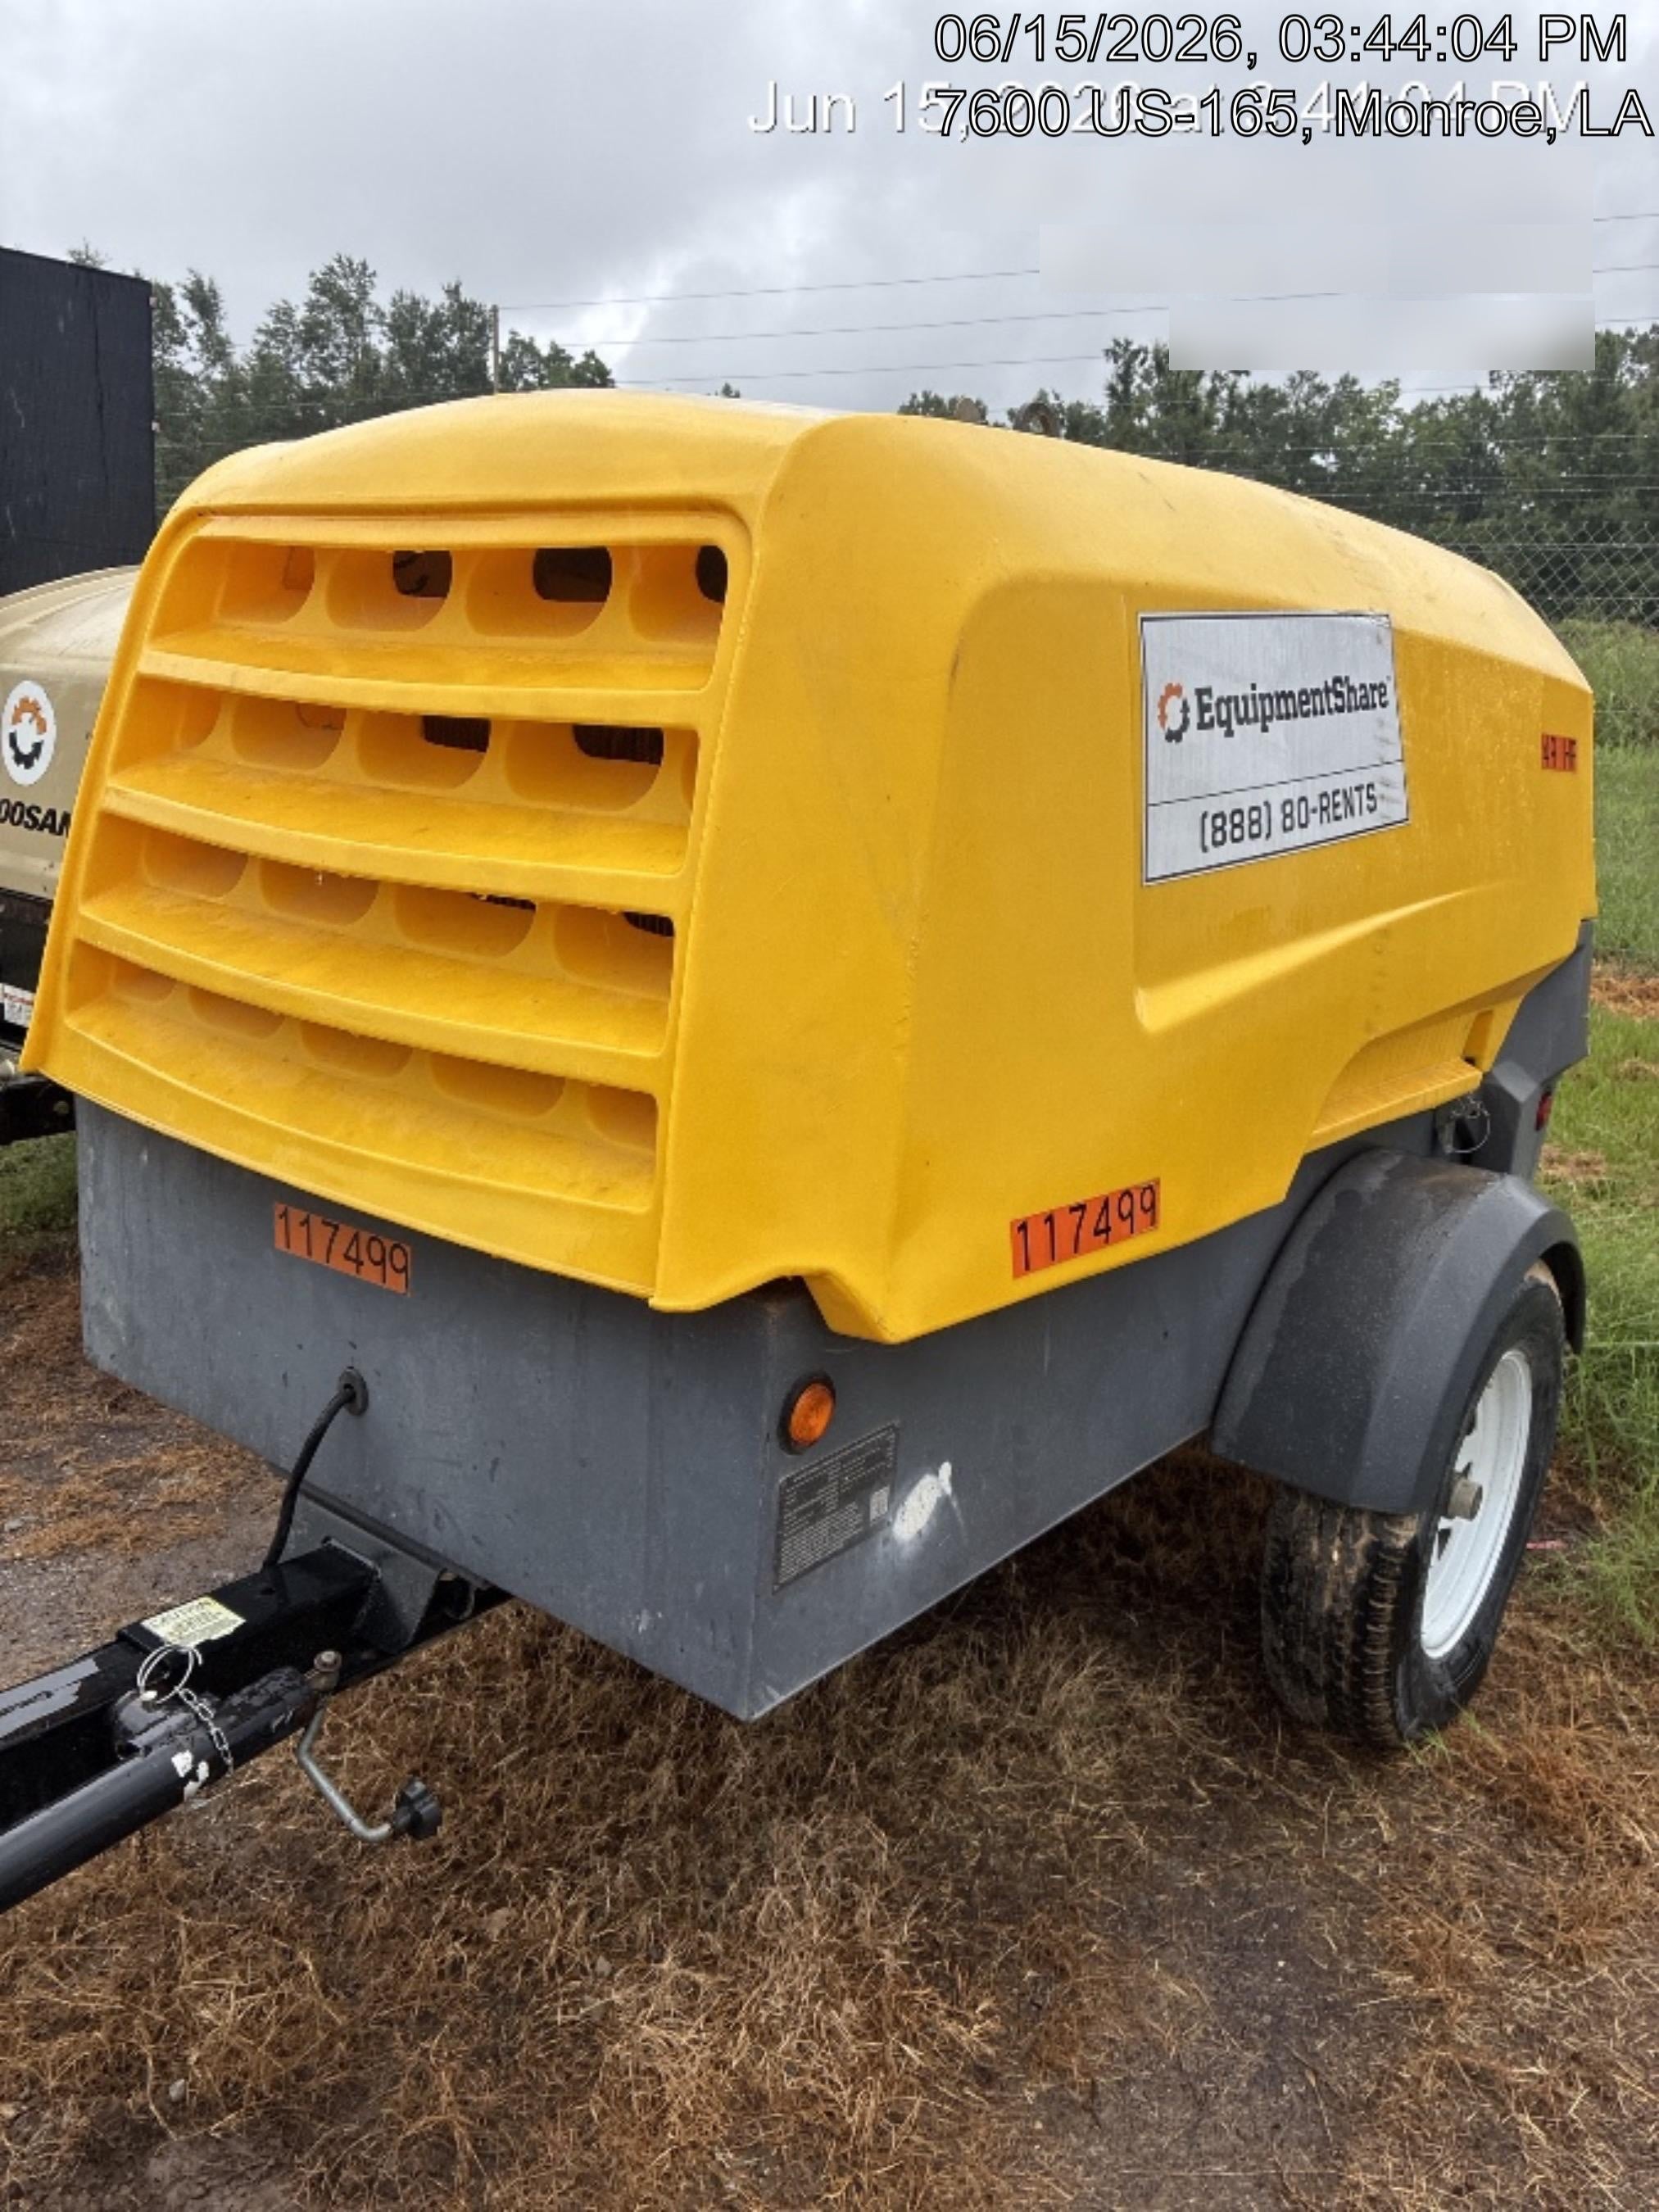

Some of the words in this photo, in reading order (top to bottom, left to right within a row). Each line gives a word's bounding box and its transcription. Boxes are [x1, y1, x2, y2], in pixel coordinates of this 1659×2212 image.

[1194, 676, 1390, 738] EquipmentShare
[1199, 800, 1271, 853] (888)
[1281, 782, 1378, 834] 80-RENTS
[278, 1205, 409, 1290] 117499
[1017, 1184, 1157, 1271] 117499
